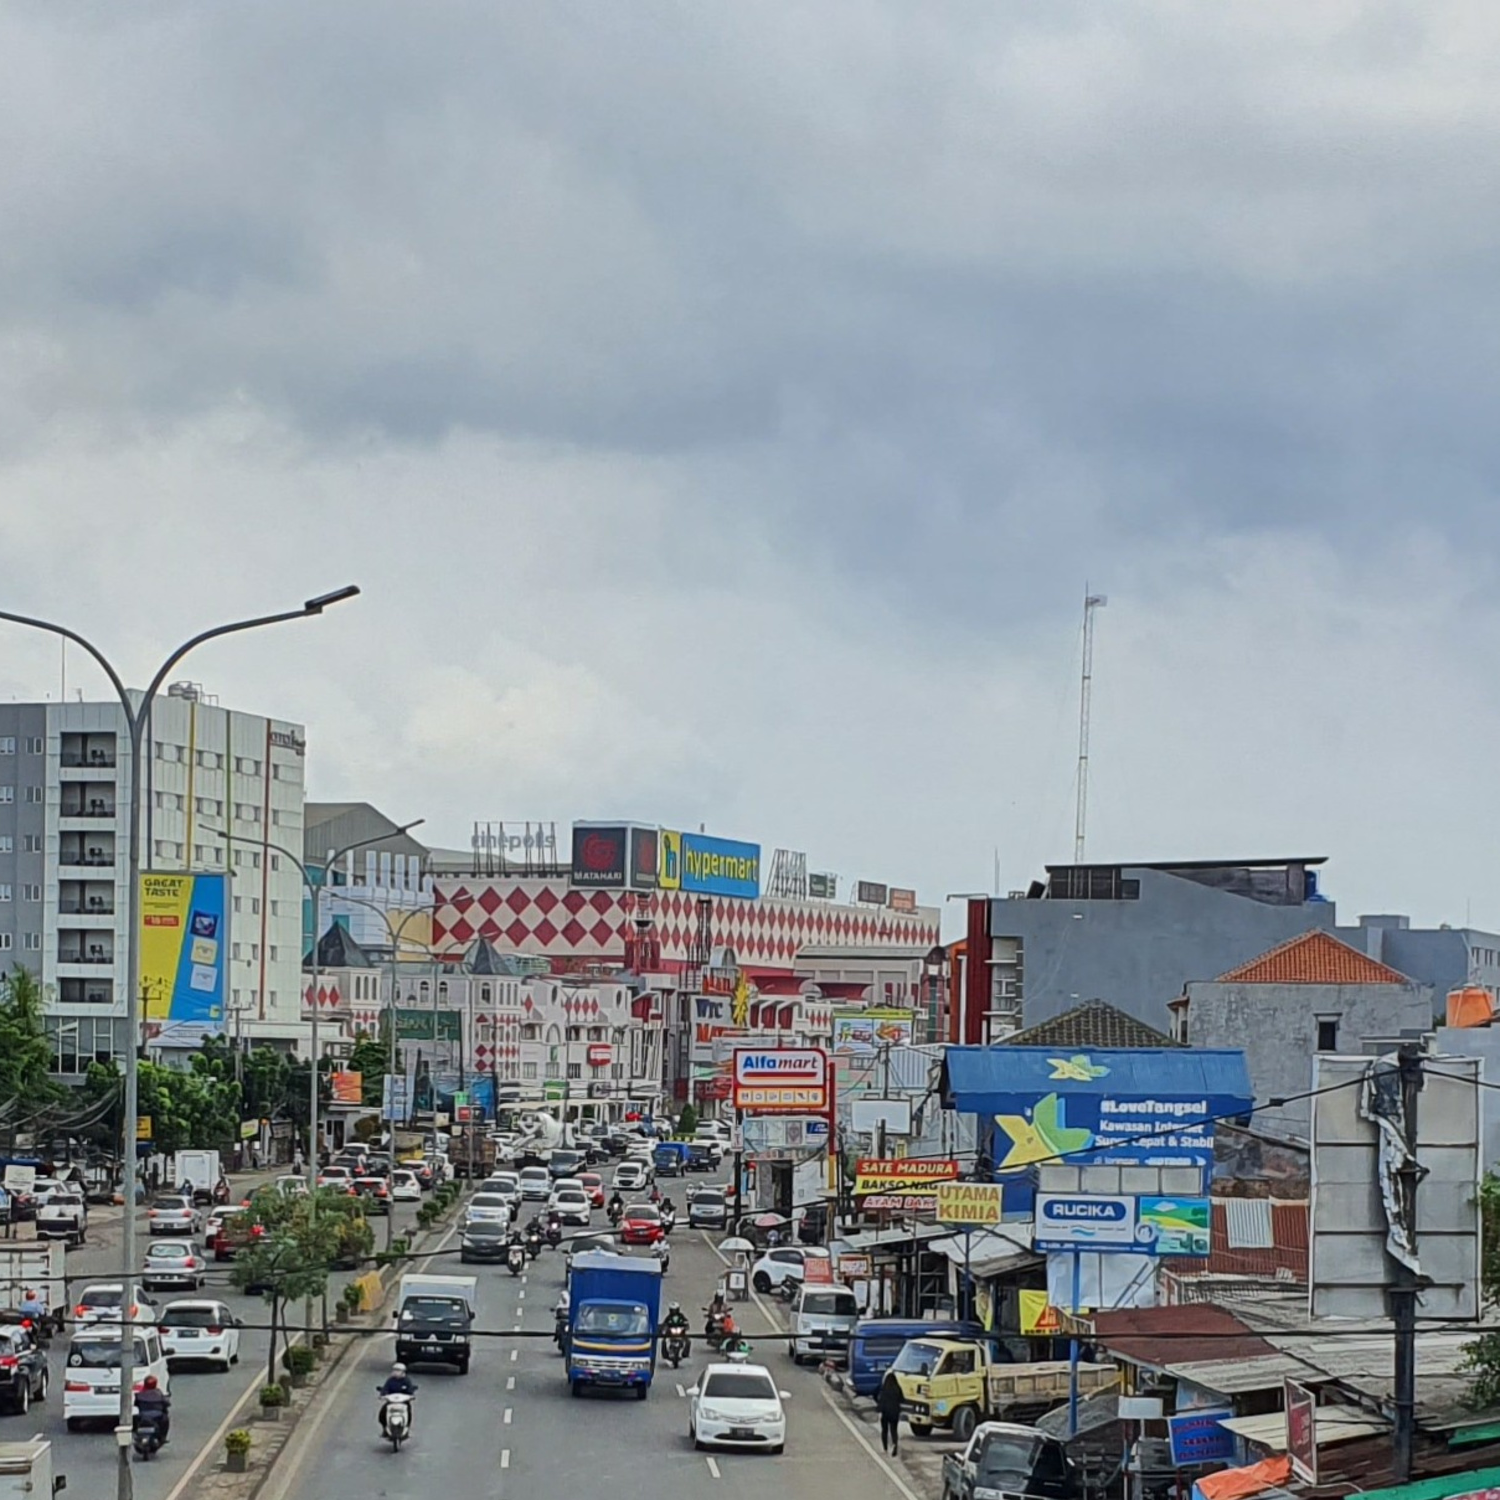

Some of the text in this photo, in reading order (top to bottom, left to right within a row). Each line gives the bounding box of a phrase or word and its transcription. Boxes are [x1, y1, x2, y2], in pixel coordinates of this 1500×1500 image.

[685, 842, 758, 882] hypermart
[574, 872, 622, 880] MATAHARI
[742, 1055, 819, 1070] Alfamart
[1100, 1120, 1152, 1132] Kawasan
[861, 1162, 954, 1174] SATE MADURA
[861, 1179, 906, 1190] BAKSO
[939, 1185, 1000, 1202] UTAMA
[939, 1204, 999, 1220] KIMIA
[1052, 1203, 1116, 1217] RUCIKA
